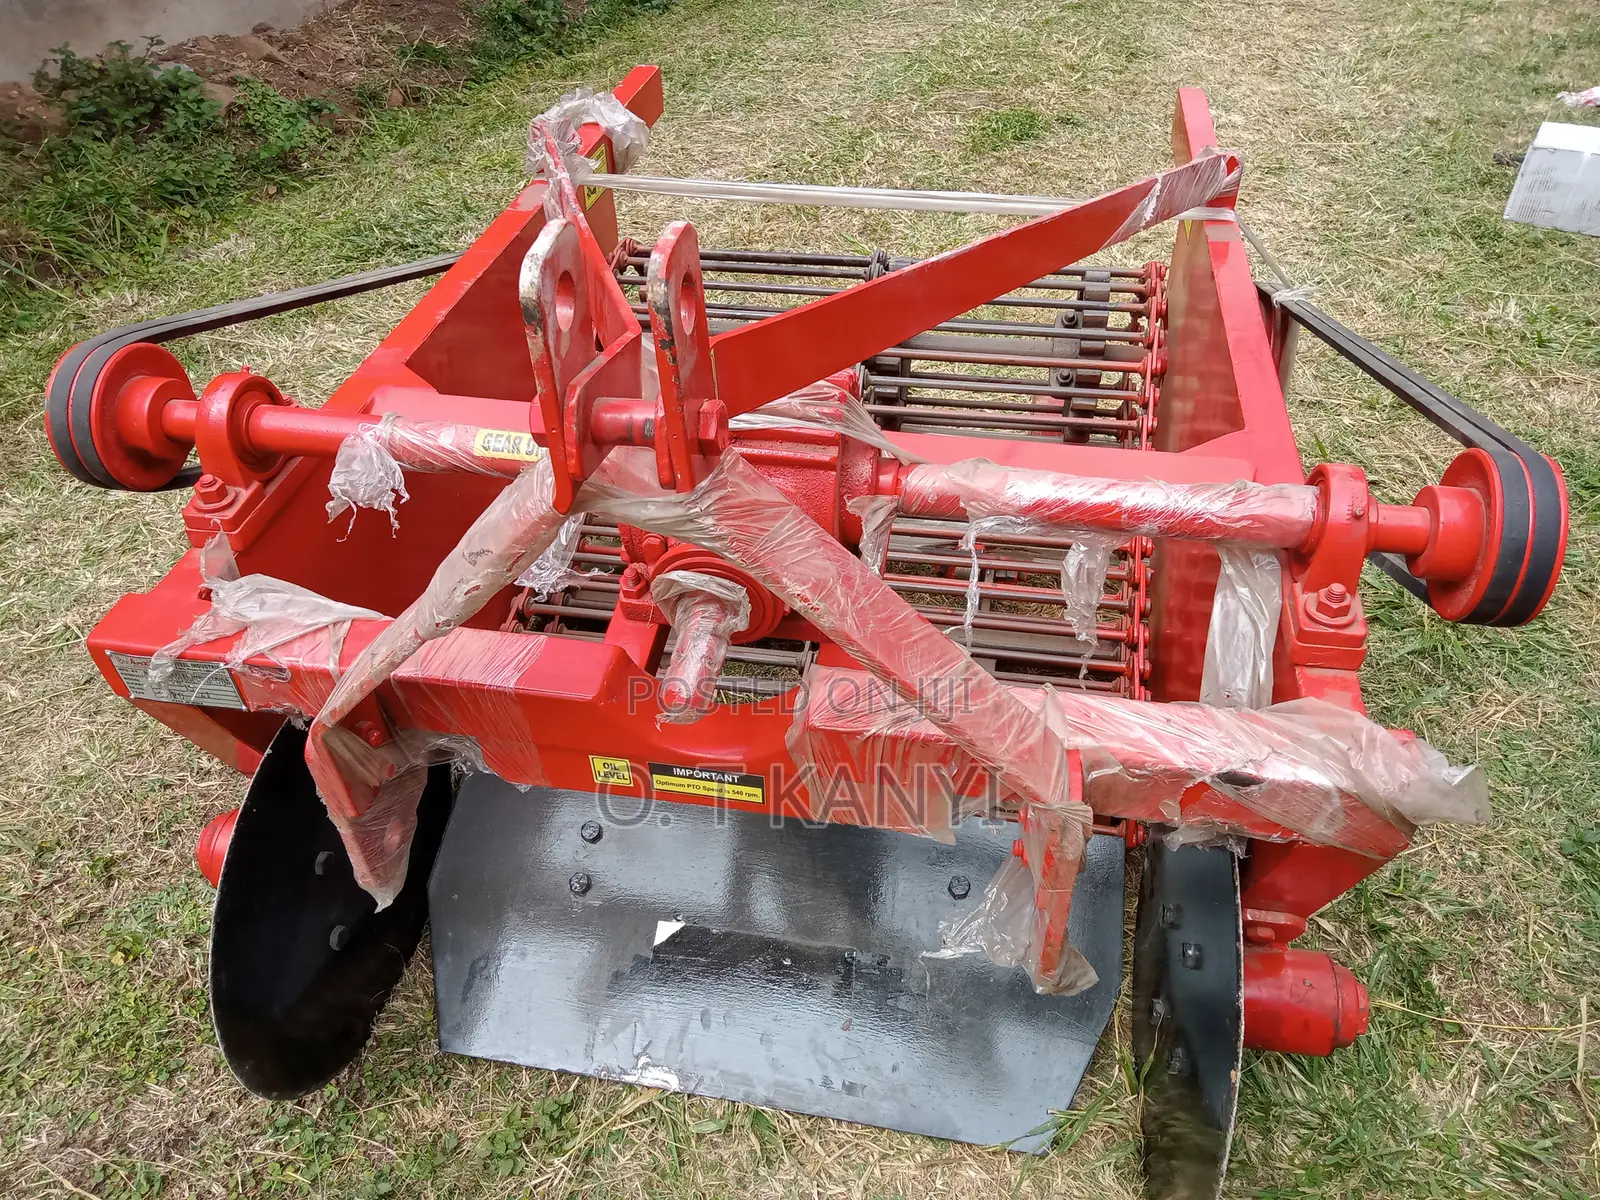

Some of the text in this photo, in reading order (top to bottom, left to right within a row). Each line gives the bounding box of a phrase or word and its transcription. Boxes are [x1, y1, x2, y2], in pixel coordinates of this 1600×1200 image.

[482, 433, 523, 454] GEAR
[602, 762, 620, 771] OIL
[597, 769, 629, 781] LEVEL
[673, 767, 740, 783] IMPORTANT
[655, 779, 686, 789] Optimum
[686, 783, 701, 791] PTO
[702, 785, 724, 794] Speed
[732, 789, 744, 797] 540
[744, 791, 761, 799] rpm.
